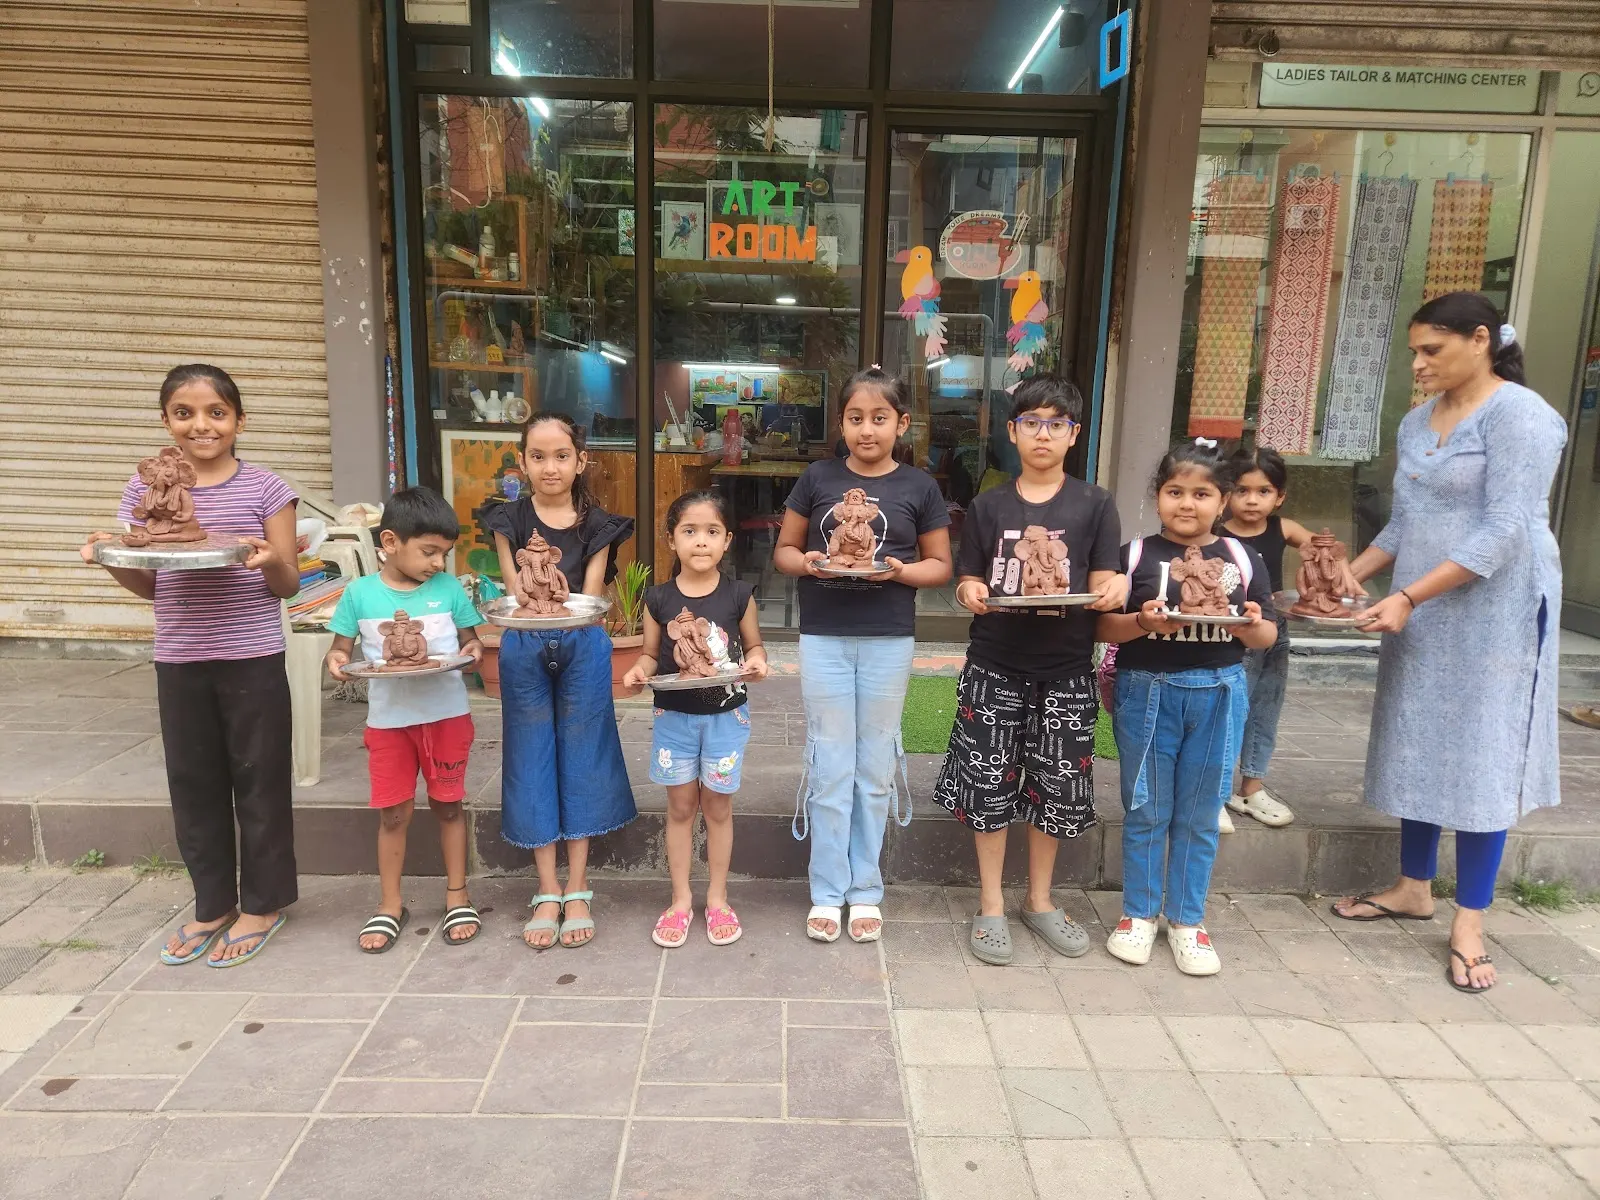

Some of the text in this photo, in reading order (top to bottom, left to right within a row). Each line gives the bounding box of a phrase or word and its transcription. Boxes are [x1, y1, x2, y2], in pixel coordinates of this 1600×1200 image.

[1276, 69, 1527, 86] LADIES TAILOR & MATCHING CENTER
[722, 180, 799, 216] ART
[947, 216, 965, 230] YOUR
[709, 222, 817, 261] ROOM
[994, 687, 1018, 698] Calvin
[1049, 690, 1073, 699] Calvin
[976, 706, 997, 725] ck
[1061, 712, 1081, 730] ck
[989, 749, 1010, 765] ck
[983, 767, 1004, 784] ck
[1059, 760, 1079, 778] ck
[1047, 799, 1072, 811] Calvin
[967, 812, 986, 830] ck
[1058, 821, 1079, 838] ck
